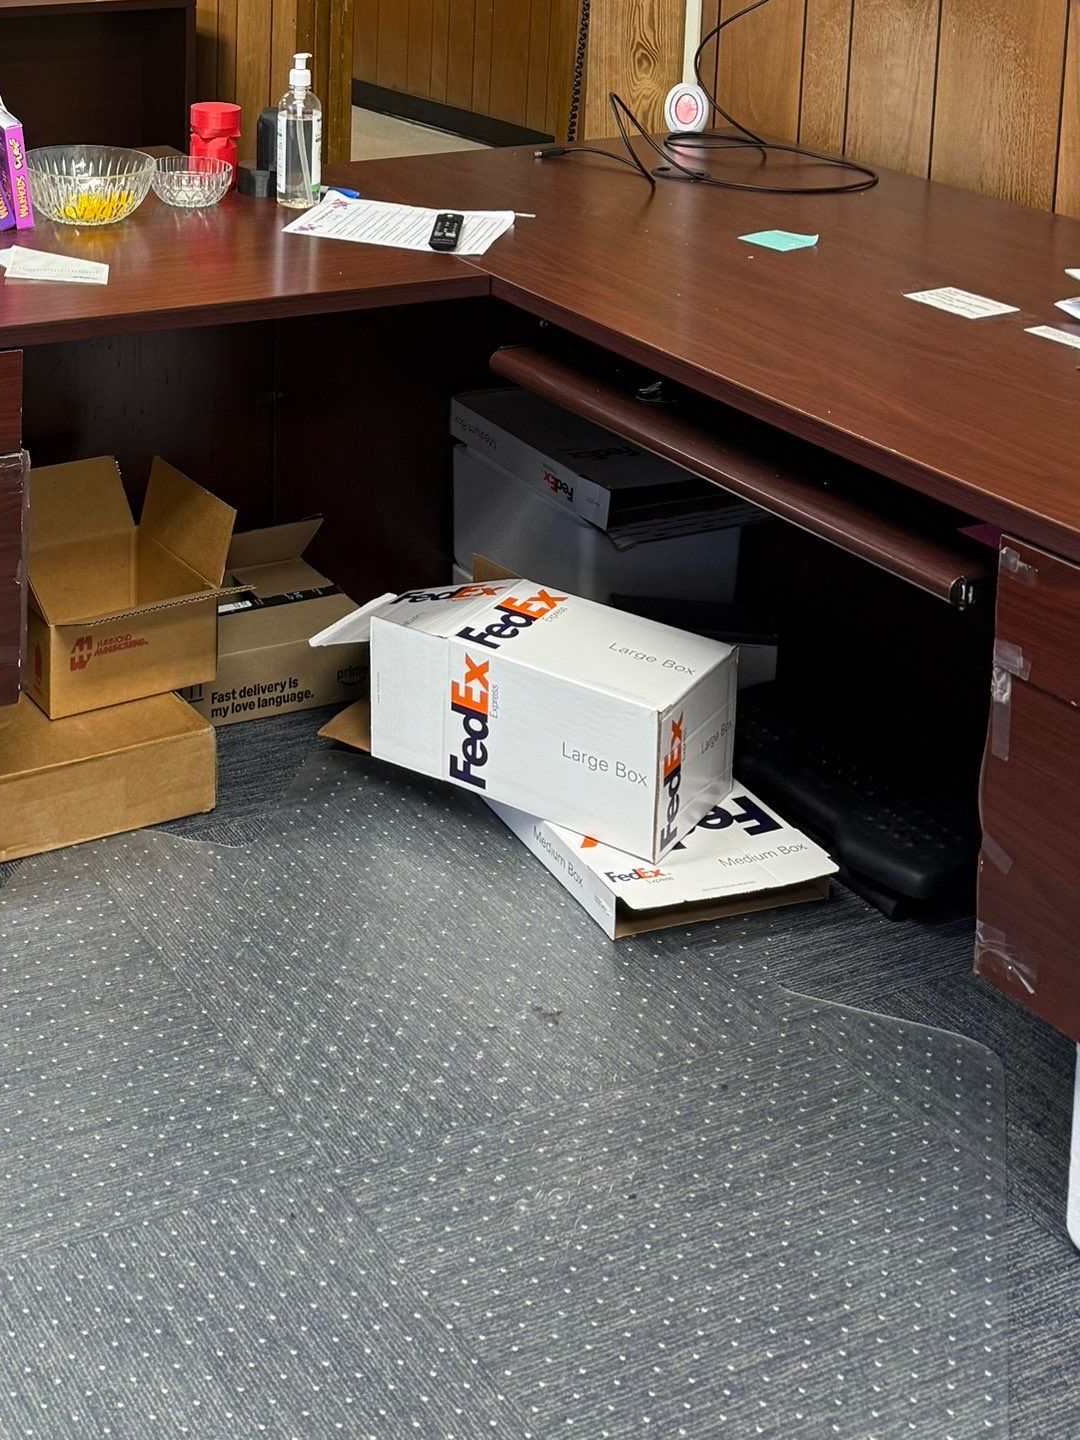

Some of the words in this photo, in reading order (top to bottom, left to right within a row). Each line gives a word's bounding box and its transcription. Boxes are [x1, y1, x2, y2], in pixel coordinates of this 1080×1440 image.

[543, 471, 574, 503] FedEx
[389, 584, 508, 605] FedEx
[456, 589, 569, 649] FedEx
[337, 665, 368, 681] prime
[609, 642, 657, 663] Large
[662, 659, 696, 676] Box
[211, 690, 237, 704] Fast
[239, 683, 287, 699] delivery
[288, 677, 299, 689] is
[211, 705, 229, 718] my
[231, 701, 255, 714] love
[257, 689, 314, 708] language.
[490, 684, 499, 719] Express
[450, 652, 489, 790] FedEx
[562, 741, 608, 771] Large
[616, 761, 648, 787] Box
[660, 711, 684, 852] FedEx
[533, 825, 566, 867] Medium
[567, 862, 584, 888] Box
[718, 848, 778, 867] Medium
[780, 841, 808, 855] Box
[604, 867, 667, 883] FedEx
